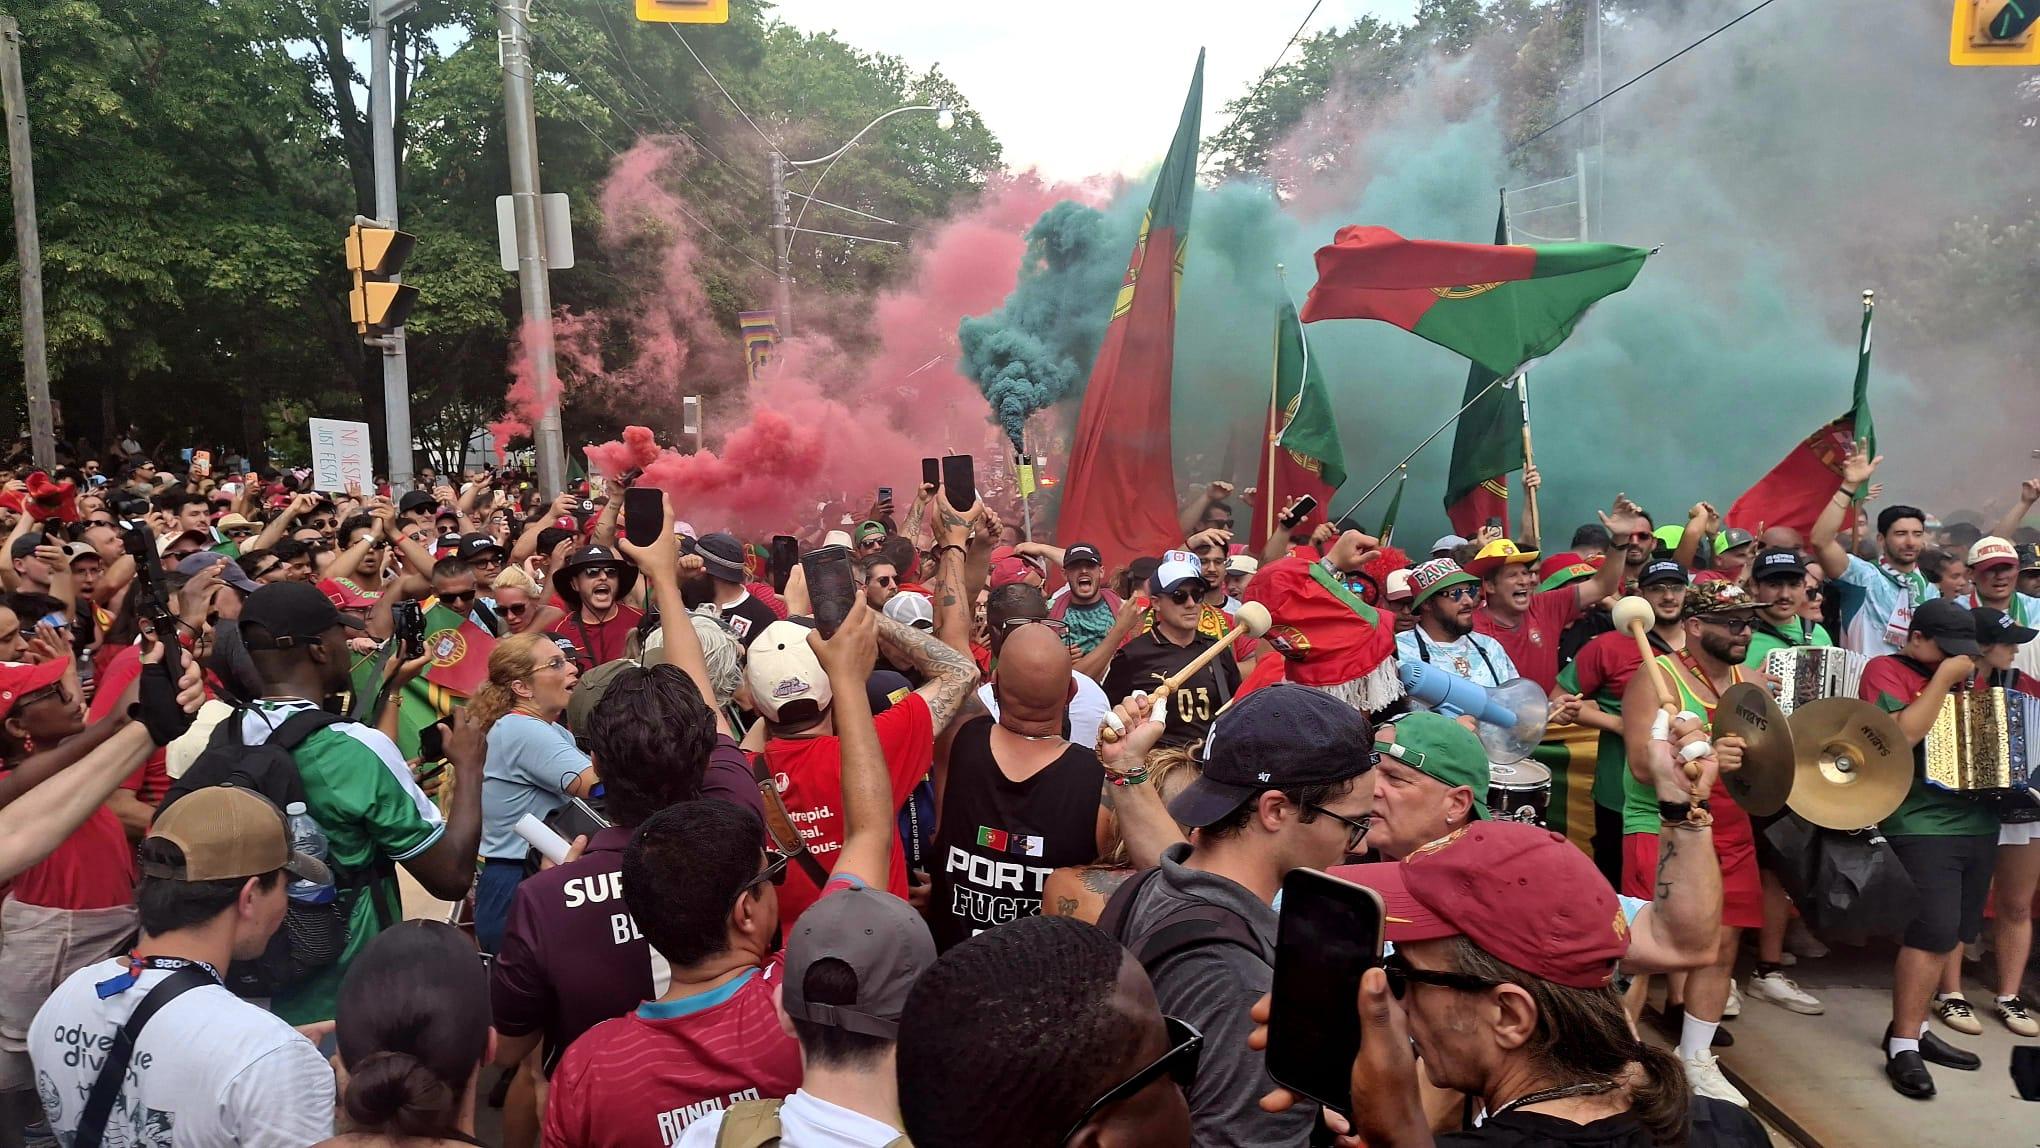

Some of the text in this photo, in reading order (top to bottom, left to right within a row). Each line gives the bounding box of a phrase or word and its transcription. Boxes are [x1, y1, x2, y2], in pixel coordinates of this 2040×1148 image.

[1177, 687, 1210, 723] 03
[788, 805, 834, 823] trepid.
[800, 825, 824, 839] eal.
